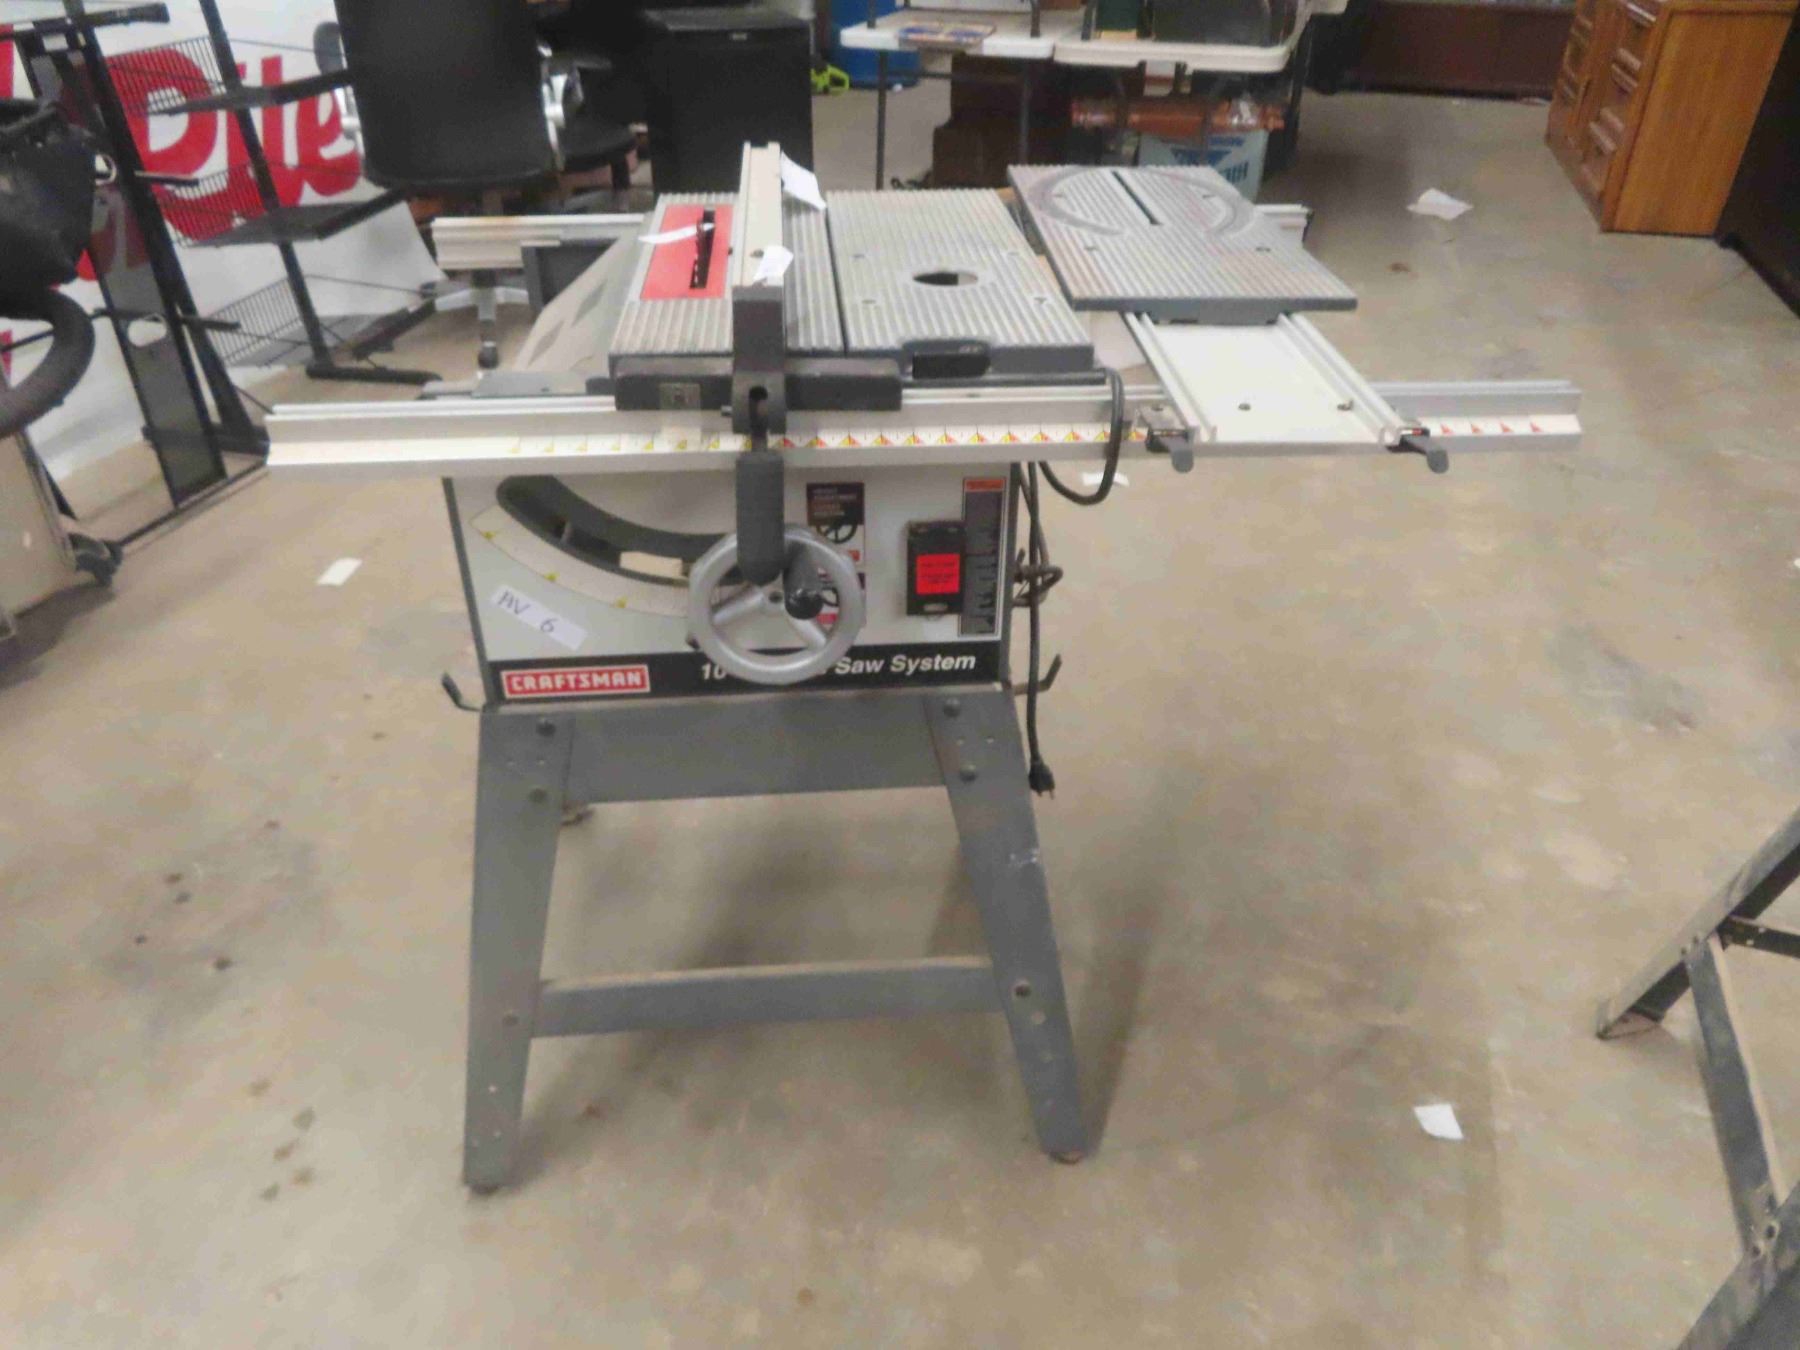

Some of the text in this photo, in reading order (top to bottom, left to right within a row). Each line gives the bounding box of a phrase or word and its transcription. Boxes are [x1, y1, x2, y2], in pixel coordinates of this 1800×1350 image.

[541, 617, 559, 633] 6
[834, 656, 885, 675] Saw
[889, 653, 976, 676] System
[509, 670, 643, 692] CRAFTSMAN
